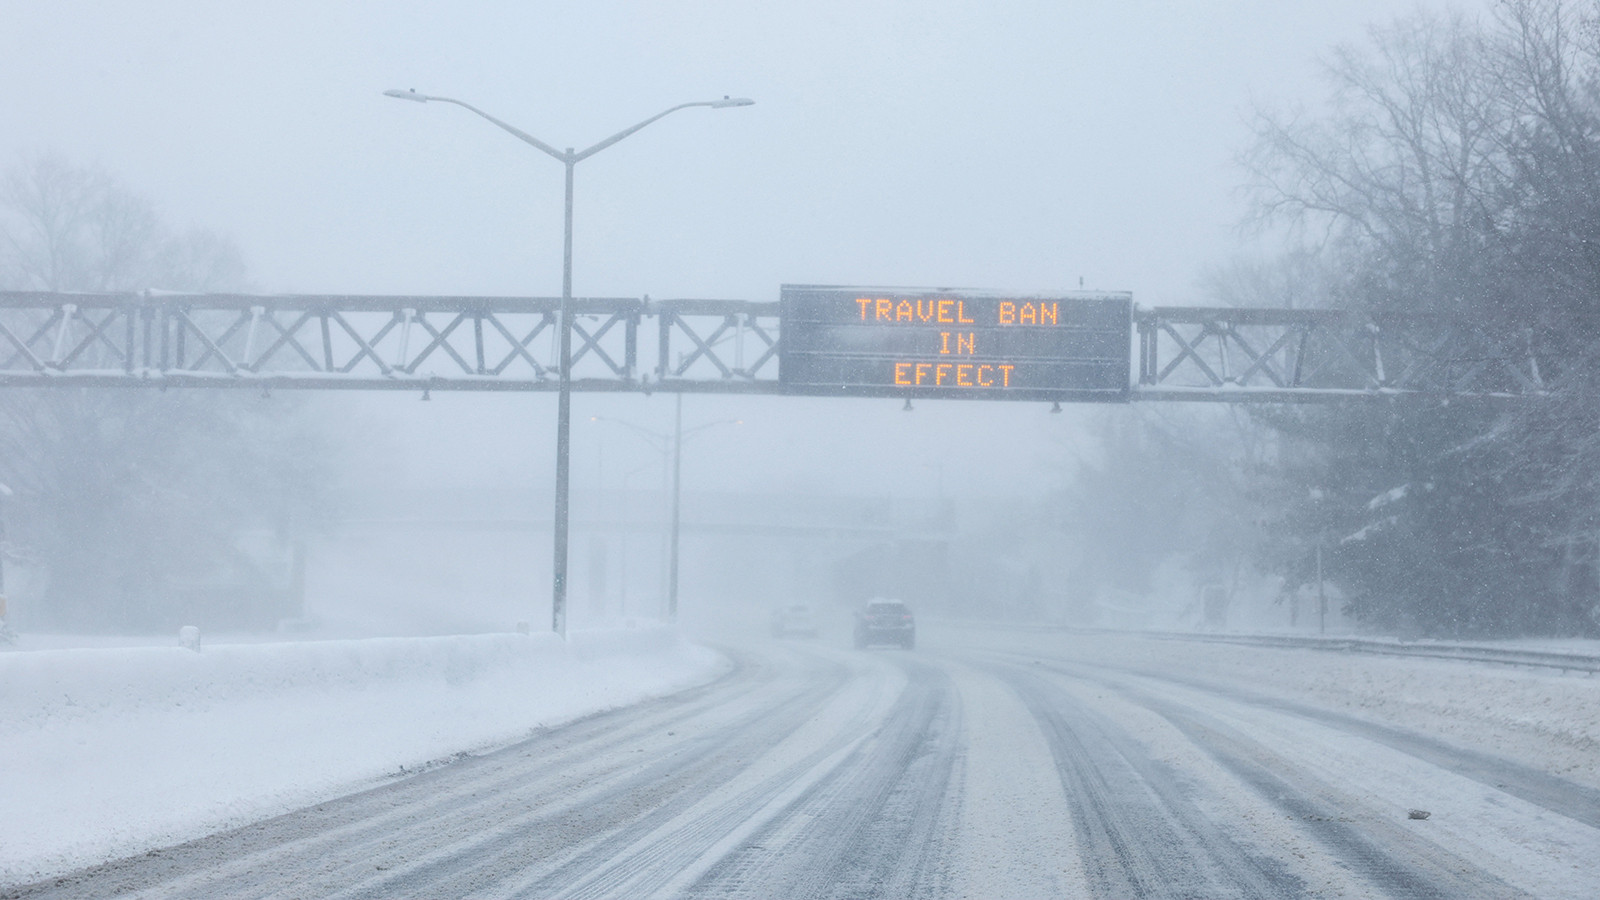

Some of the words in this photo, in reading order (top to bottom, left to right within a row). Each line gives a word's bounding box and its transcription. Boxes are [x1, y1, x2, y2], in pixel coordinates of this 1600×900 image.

[855, 298, 975, 324] TRAVEL
[999, 301, 1058, 325] BAN
[939, 332, 975, 355] IN
[894, 362, 1015, 387] EFFECT
